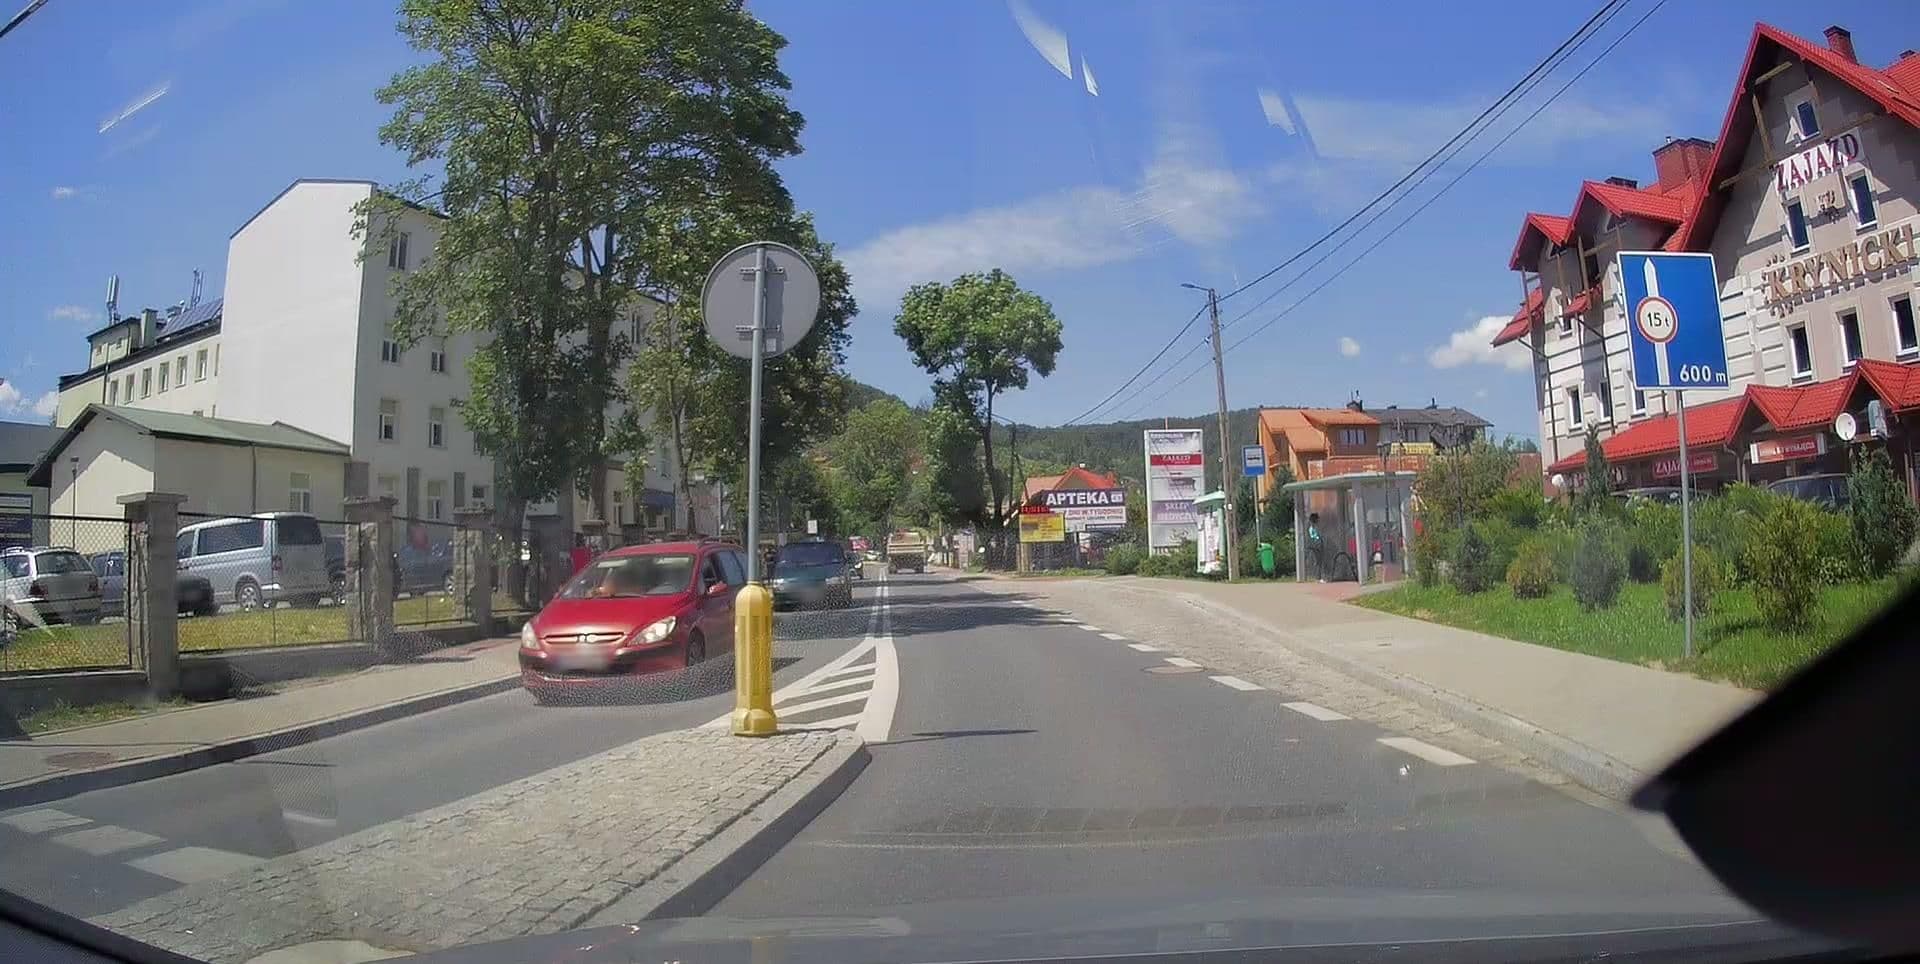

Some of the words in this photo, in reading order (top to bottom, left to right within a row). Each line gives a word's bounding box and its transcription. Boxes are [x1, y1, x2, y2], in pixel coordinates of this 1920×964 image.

[1775, 133, 1859, 193] ZAJAZD
[1766, 224, 1917, 303] KRYNICKI
[1647, 312, 1662, 327] 15
[1664, 317, 1670, 327] t
[1680, 364, 1711, 382] 600
[1715, 372, 1726, 383] m
[1046, 491, 1109, 505] APTEKA
